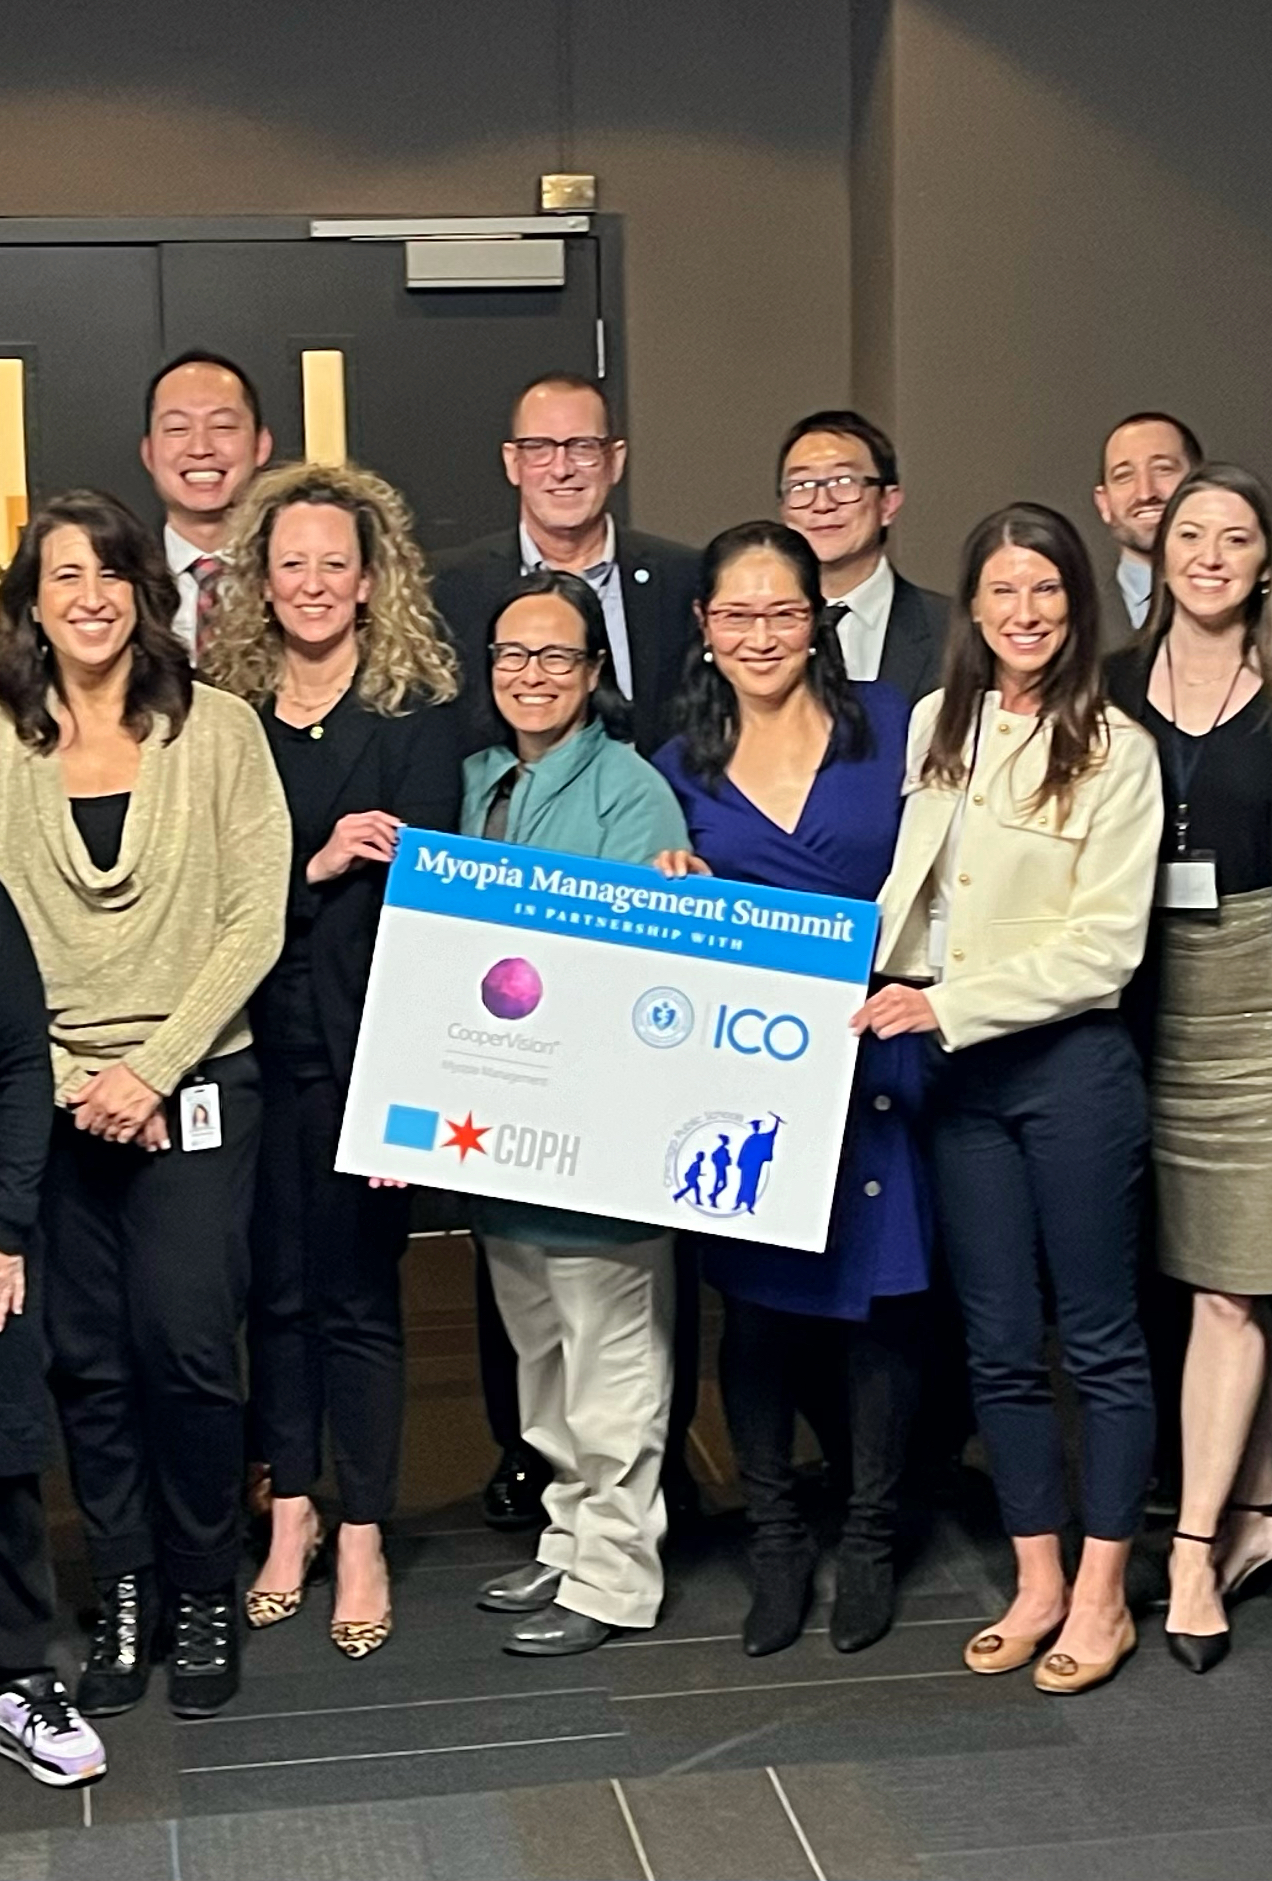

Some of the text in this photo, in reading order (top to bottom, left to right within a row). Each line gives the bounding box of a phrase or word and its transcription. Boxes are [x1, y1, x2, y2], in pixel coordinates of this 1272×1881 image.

[414, 847, 855, 943] Myopia Management Summit
[514, 902, 744, 951] IN PARTNERSHIP WITH
[713, 1004, 810, 1062] ICO
[493, 1123, 581, 1177] CDPH
